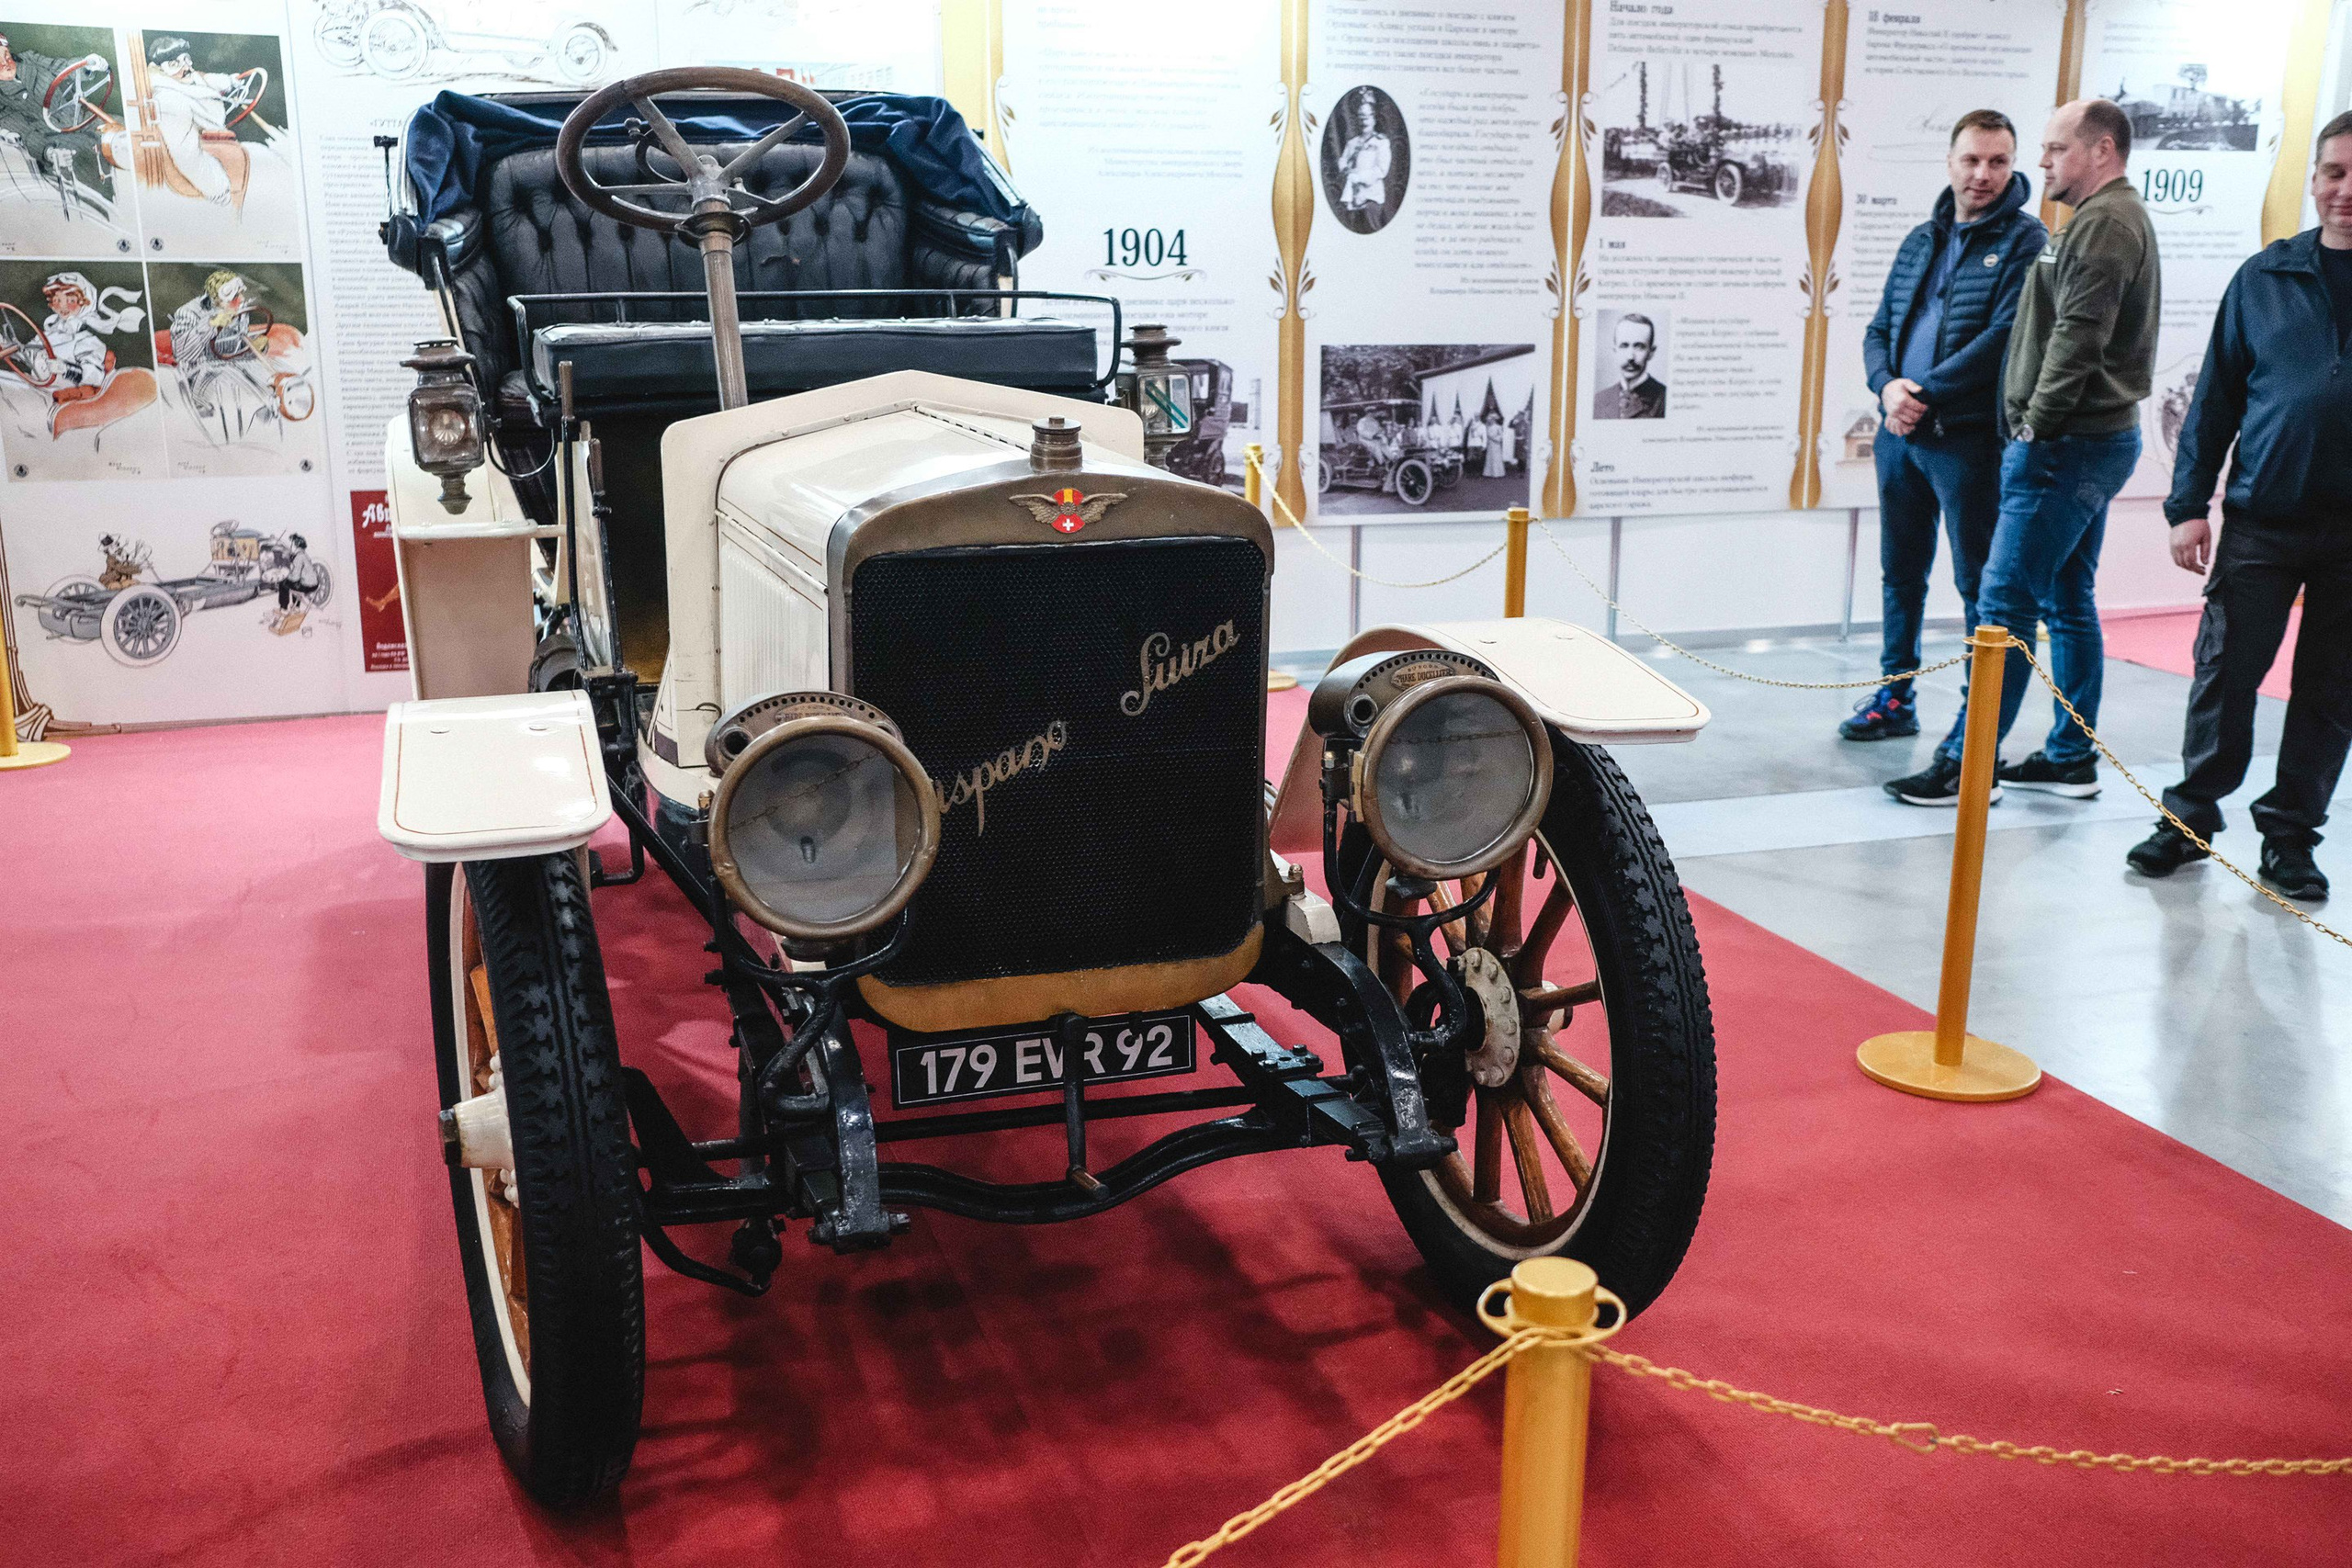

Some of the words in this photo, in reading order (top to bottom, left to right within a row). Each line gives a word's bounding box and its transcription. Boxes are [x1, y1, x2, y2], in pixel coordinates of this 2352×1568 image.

[2143, 168, 2204, 203] 1909
[1102, 227, 1188, 267] 1904
[1590, 461, 1615, 473] Лето
[934, 718, 1069, 838] ispano
[1119, 618, 1241, 717] Suiza
[920, 1043, 998, 1095] 179
[1015, 1031, 1106, 1085] EVR
[1115, 1023, 1173, 1073] 92
